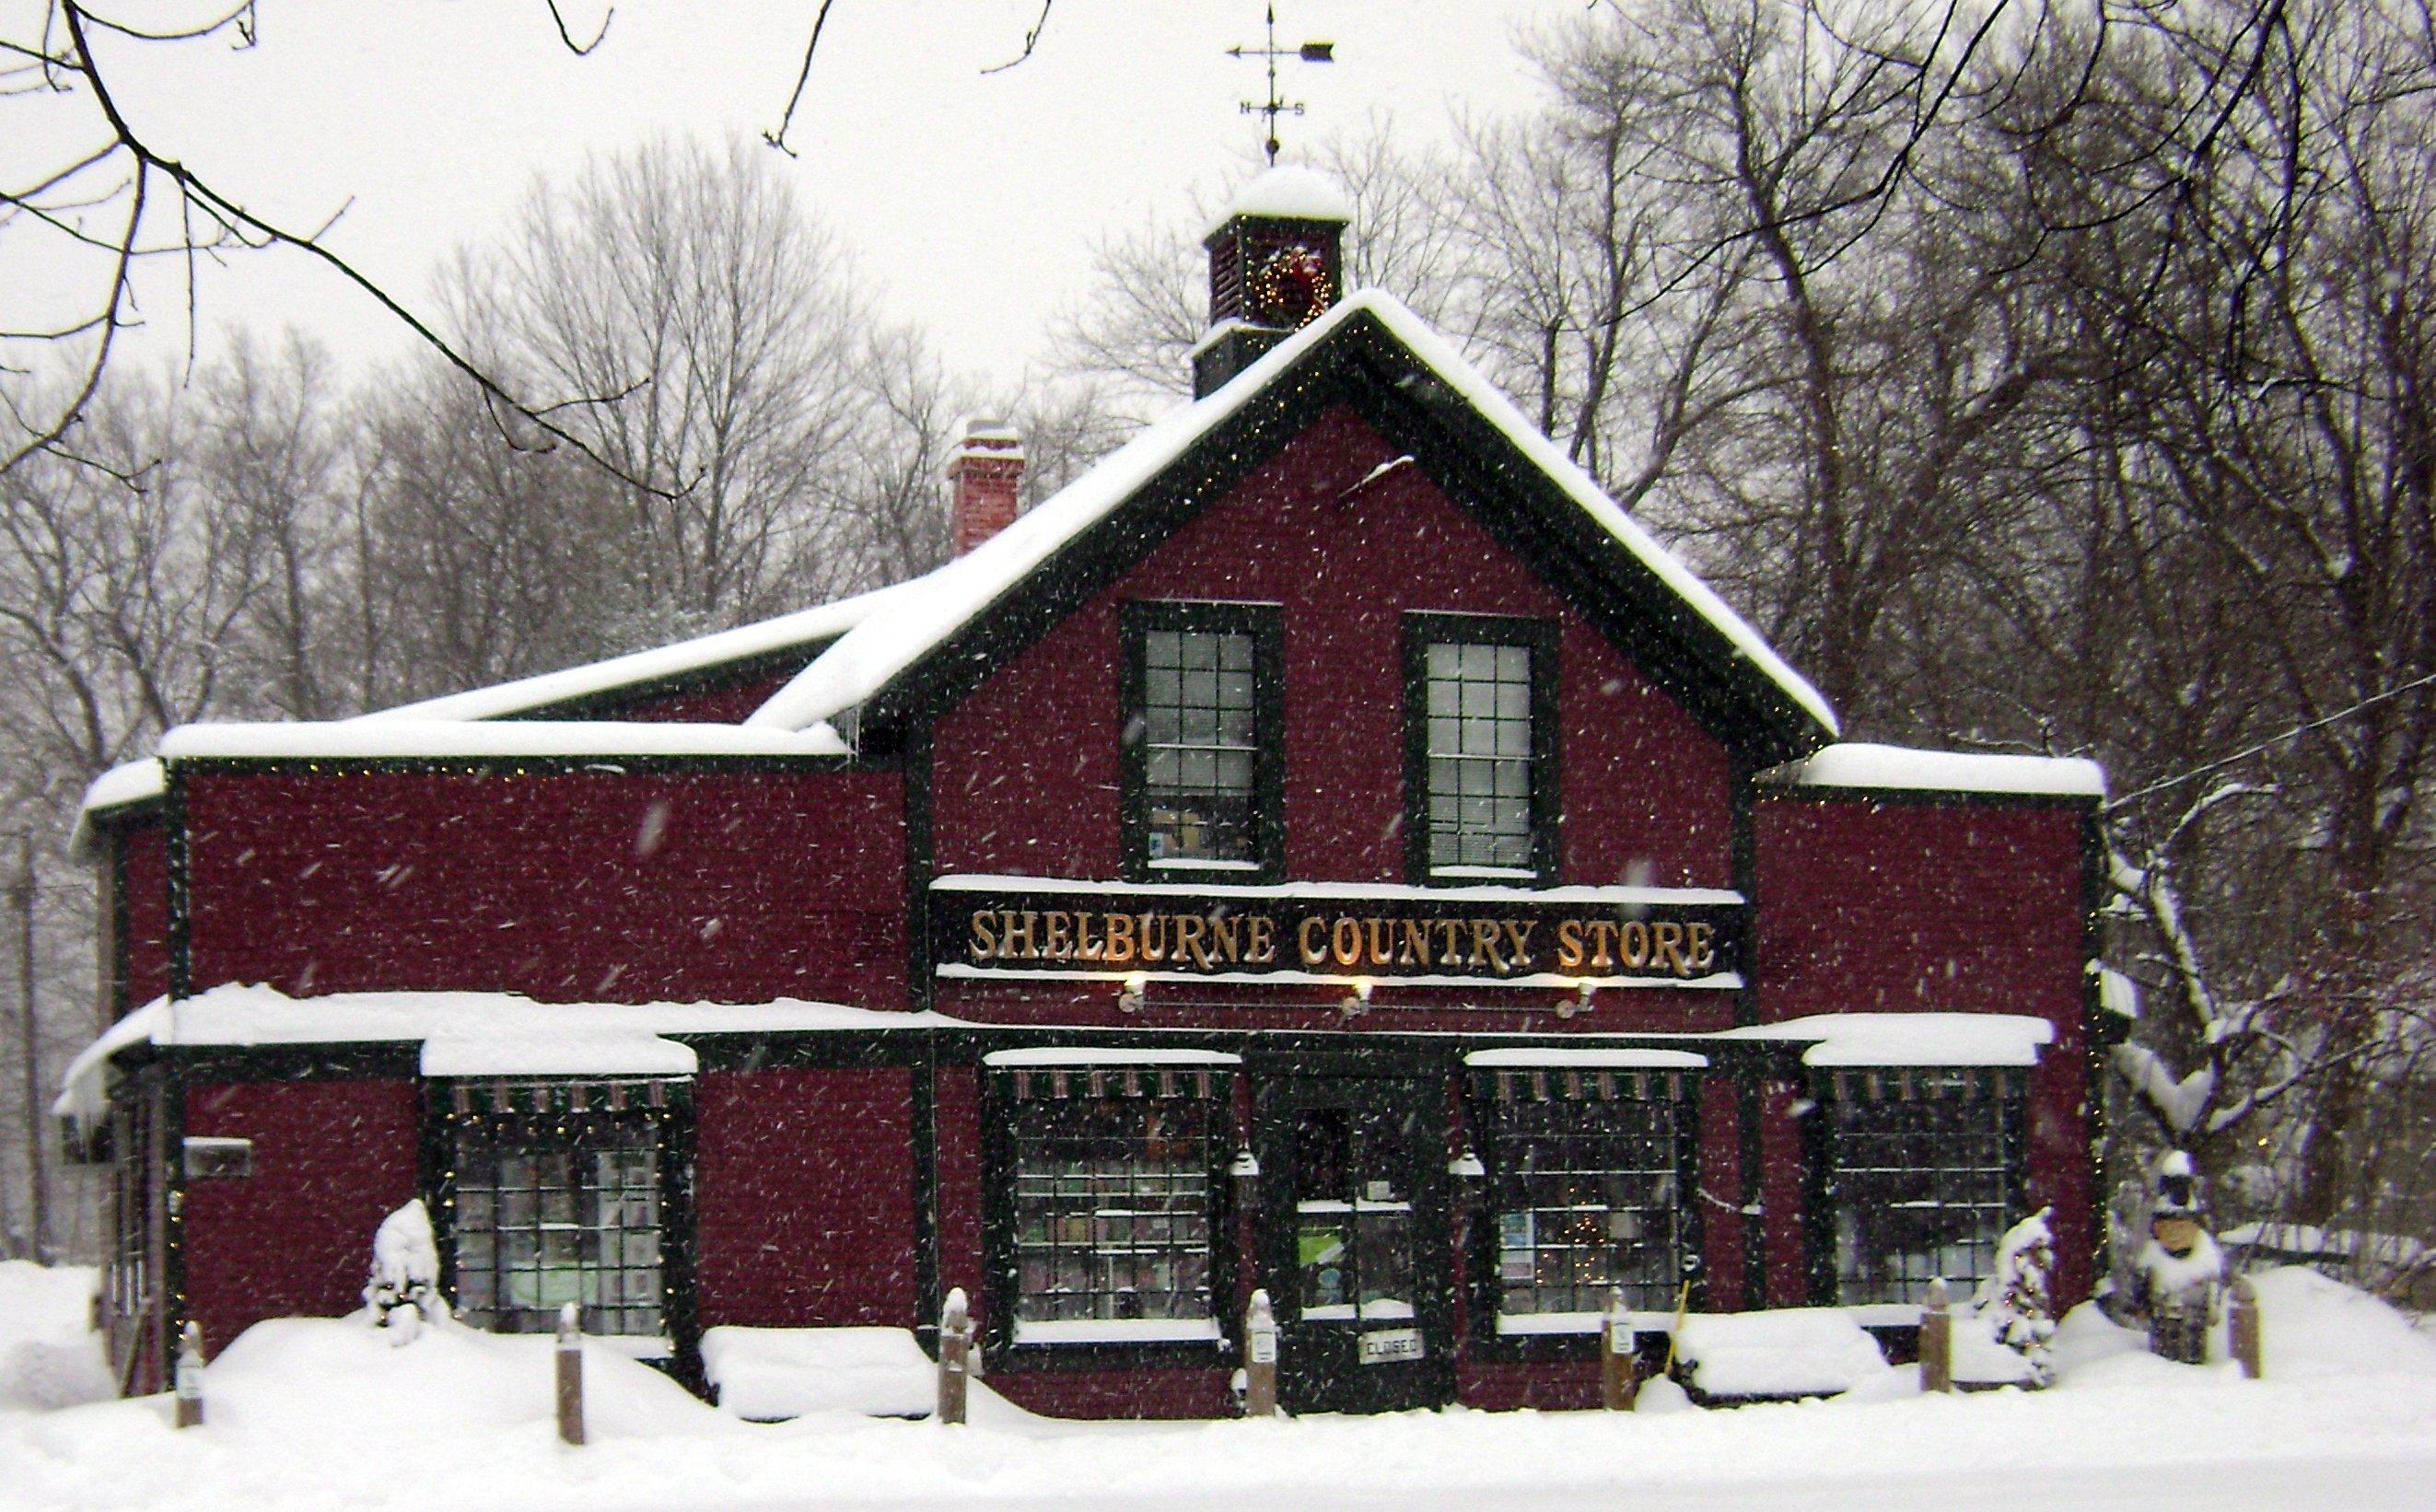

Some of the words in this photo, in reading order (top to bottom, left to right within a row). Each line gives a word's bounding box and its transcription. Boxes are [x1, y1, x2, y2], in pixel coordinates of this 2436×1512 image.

[1240, 101, 1251, 114] N
[1294, 102, 1305, 115] S
[969, 910, 1275, 970] SHELBURNE
[1300, 915, 1537, 973] COUNTRY
[1557, 921, 1716, 976] STORE
[1367, 1339, 1417, 1355] CLOSED
